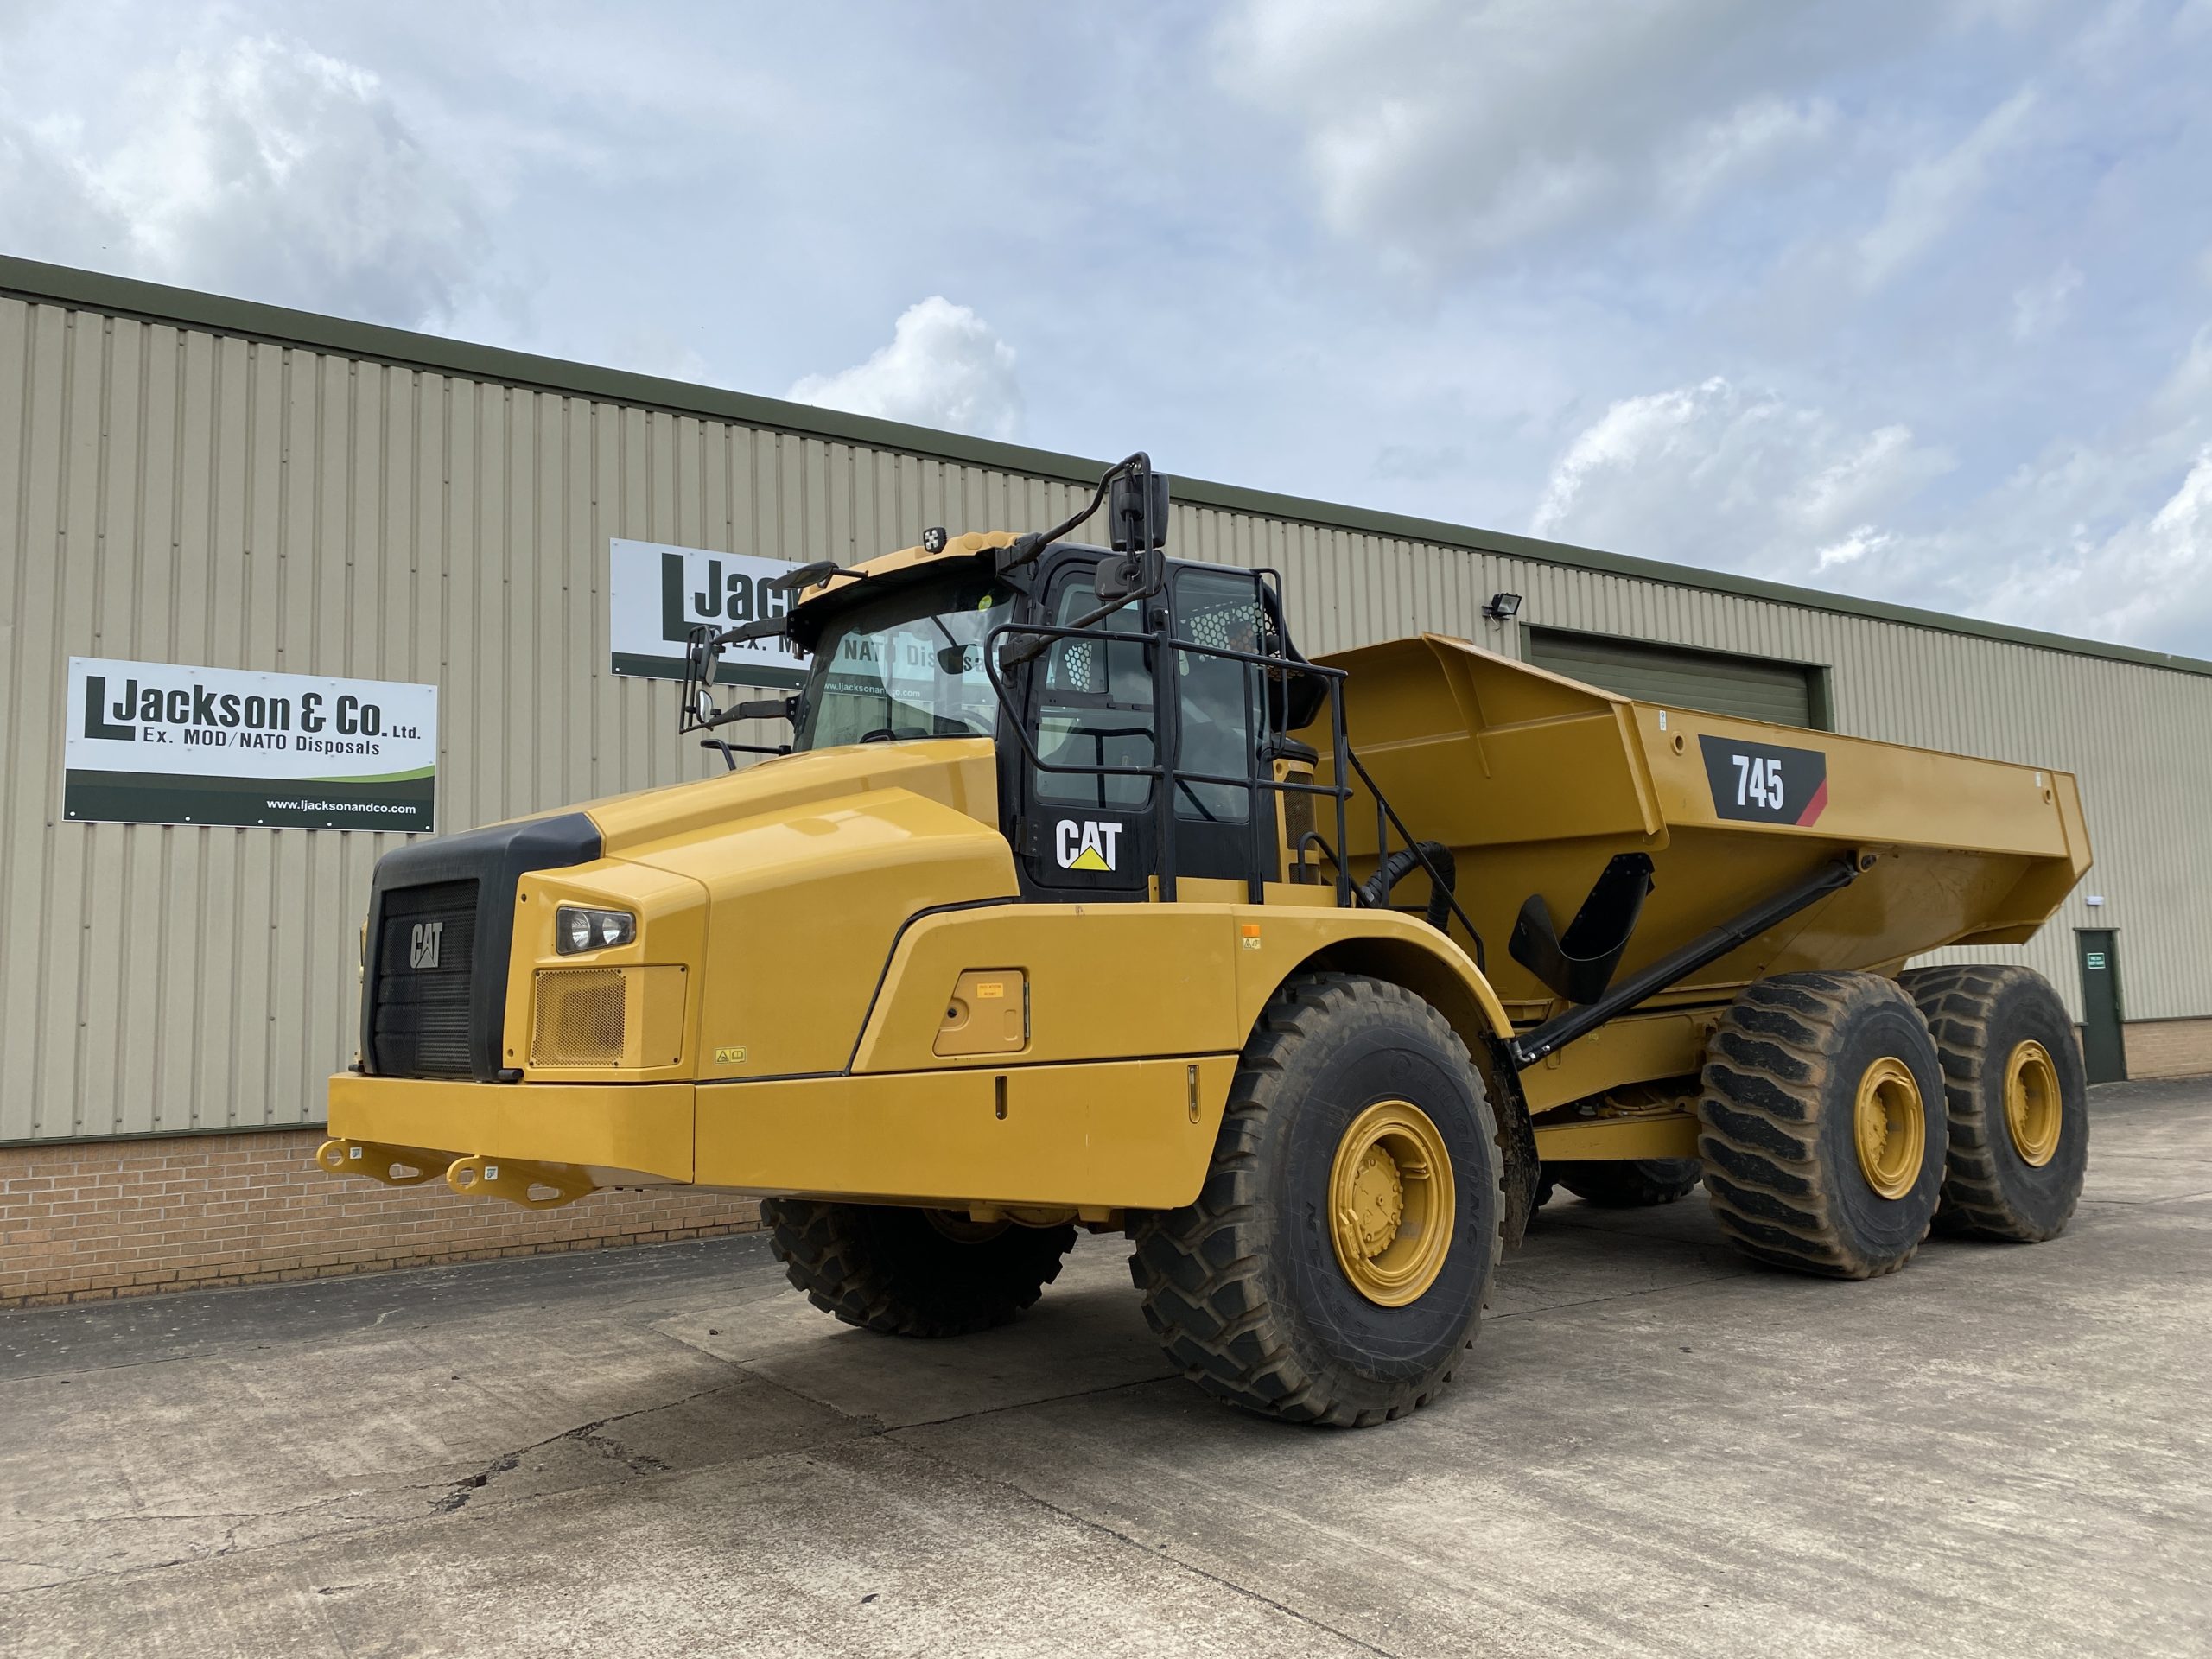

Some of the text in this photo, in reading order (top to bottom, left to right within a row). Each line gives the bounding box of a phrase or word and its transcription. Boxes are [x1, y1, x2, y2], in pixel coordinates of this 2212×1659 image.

[301, 692, 327, 733] &
[336, 695, 388, 737] Co.
[392, 725, 421, 740] Ltd.
[143, 726, 380, 755] Ex. MOD/NATO Disposals
[1732, 754, 1784, 810] 745
[266, 799, 416, 814] www.ljacksonandco.com
[1056, 819, 1122, 871] CAT
[410, 922, 443, 968] CAT
